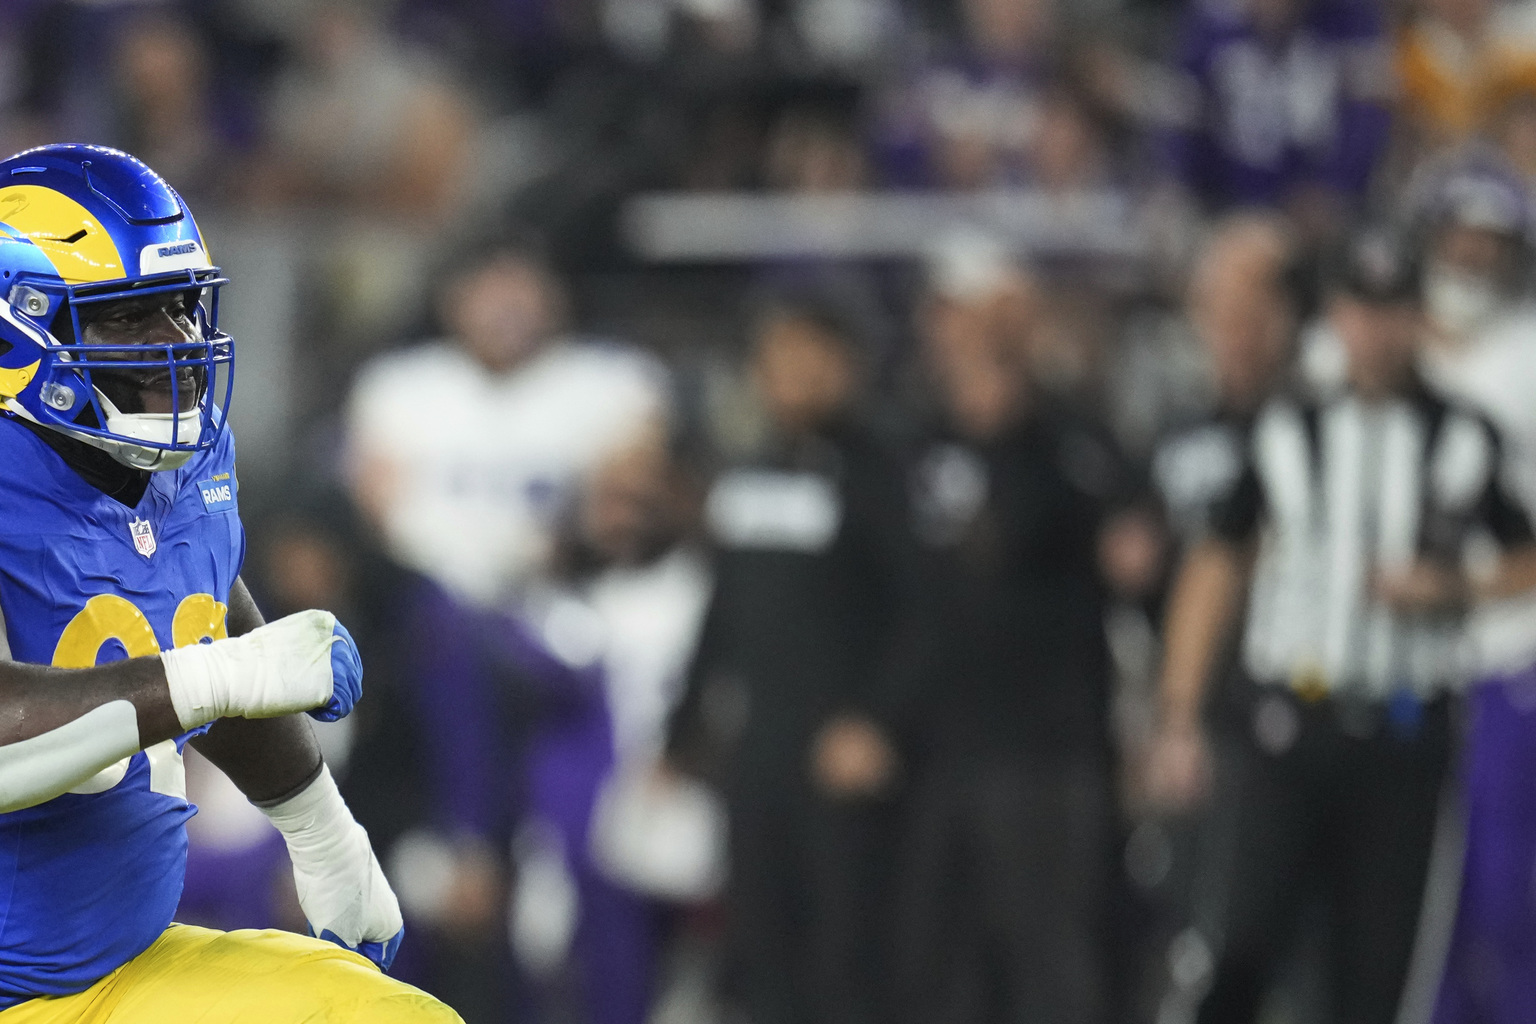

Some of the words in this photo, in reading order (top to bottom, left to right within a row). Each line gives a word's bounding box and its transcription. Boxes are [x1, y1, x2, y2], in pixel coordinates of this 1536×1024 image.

[157, 243, 196, 257] RAMS
[202, 485, 231, 504] RAMS
[136, 535, 153, 550] NFL
